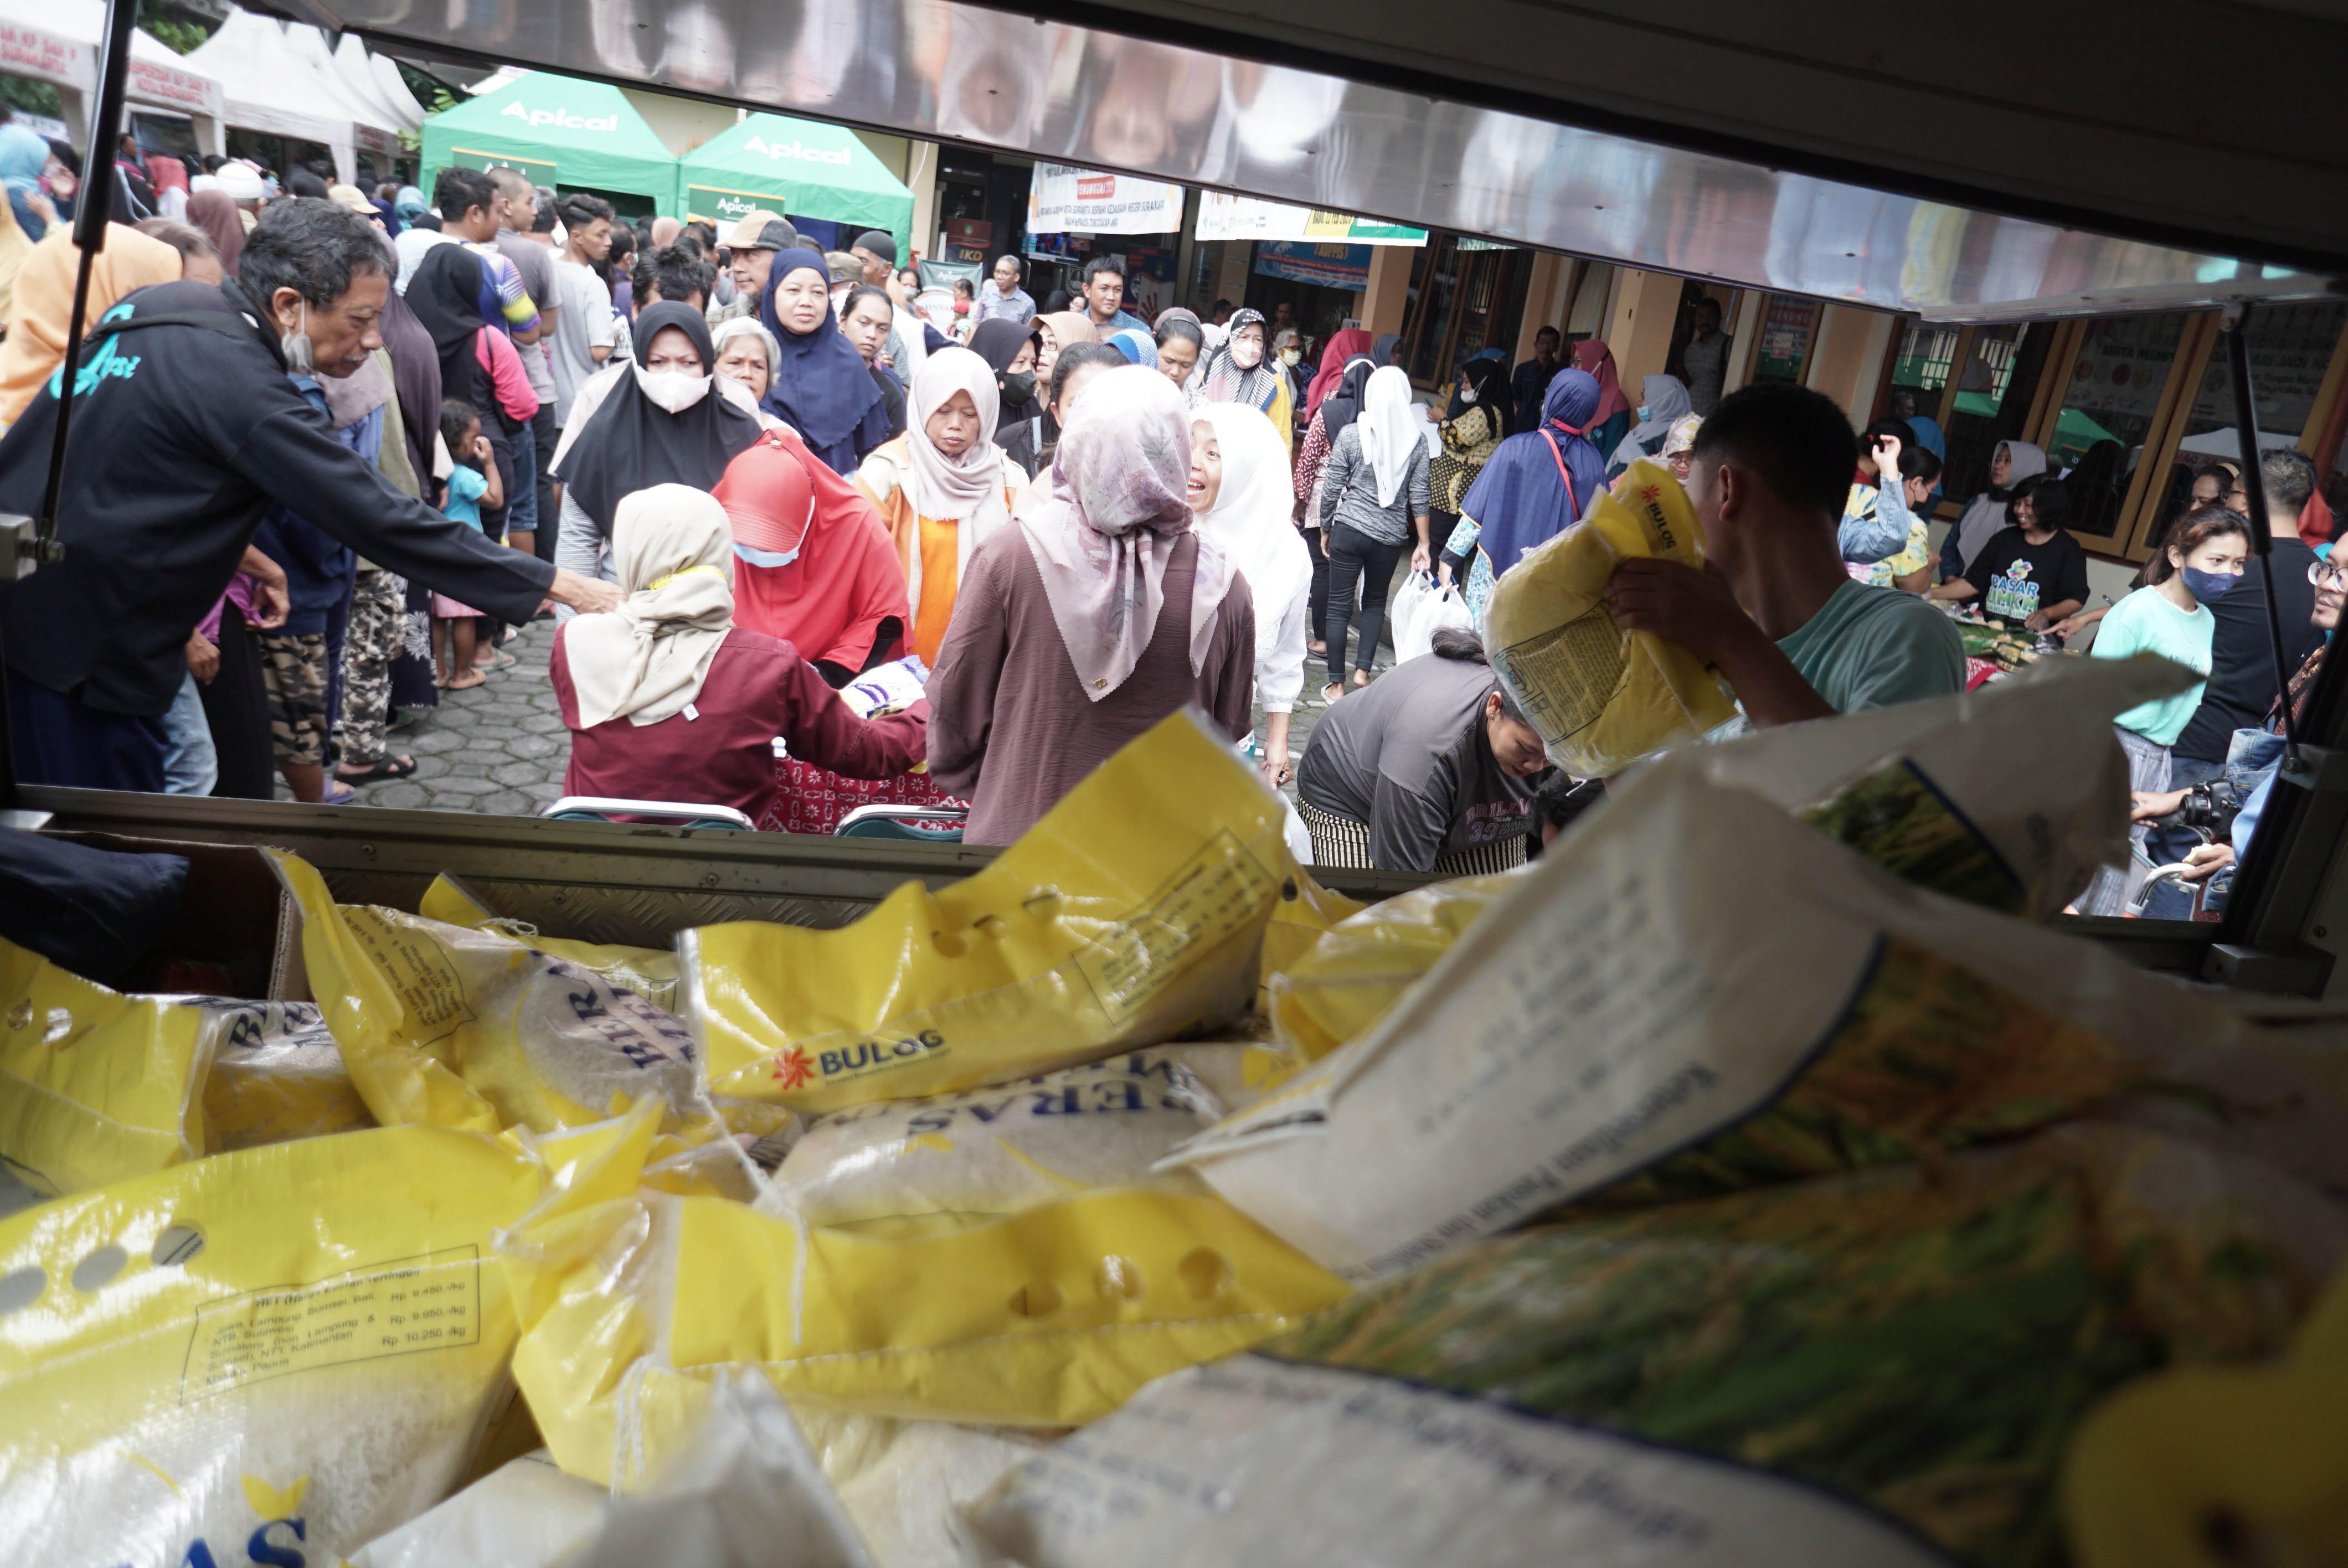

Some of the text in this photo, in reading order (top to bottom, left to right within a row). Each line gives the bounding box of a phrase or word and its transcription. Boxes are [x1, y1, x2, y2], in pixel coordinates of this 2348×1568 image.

[500, 101, 617, 133] Apical
[744, 135, 851, 166] Apical
[717, 197, 755, 215] Apical
[959, 249, 983, 261] IKD
[938, 271, 962, 281] Apical
[1649, 502, 1677, 550] BULOG
[1991, 574, 2040, 596] PASAR
[1986, 587, 2040, 613] UMKM
[1469, 821, 1499, 842] 39
[820, 1029, 945, 1075] BULOG
[308, 1318, 358, 1338] Lampung
[368, 1314, 375, 1323] &
[292, 1331, 353, 1352] Kalimantan
